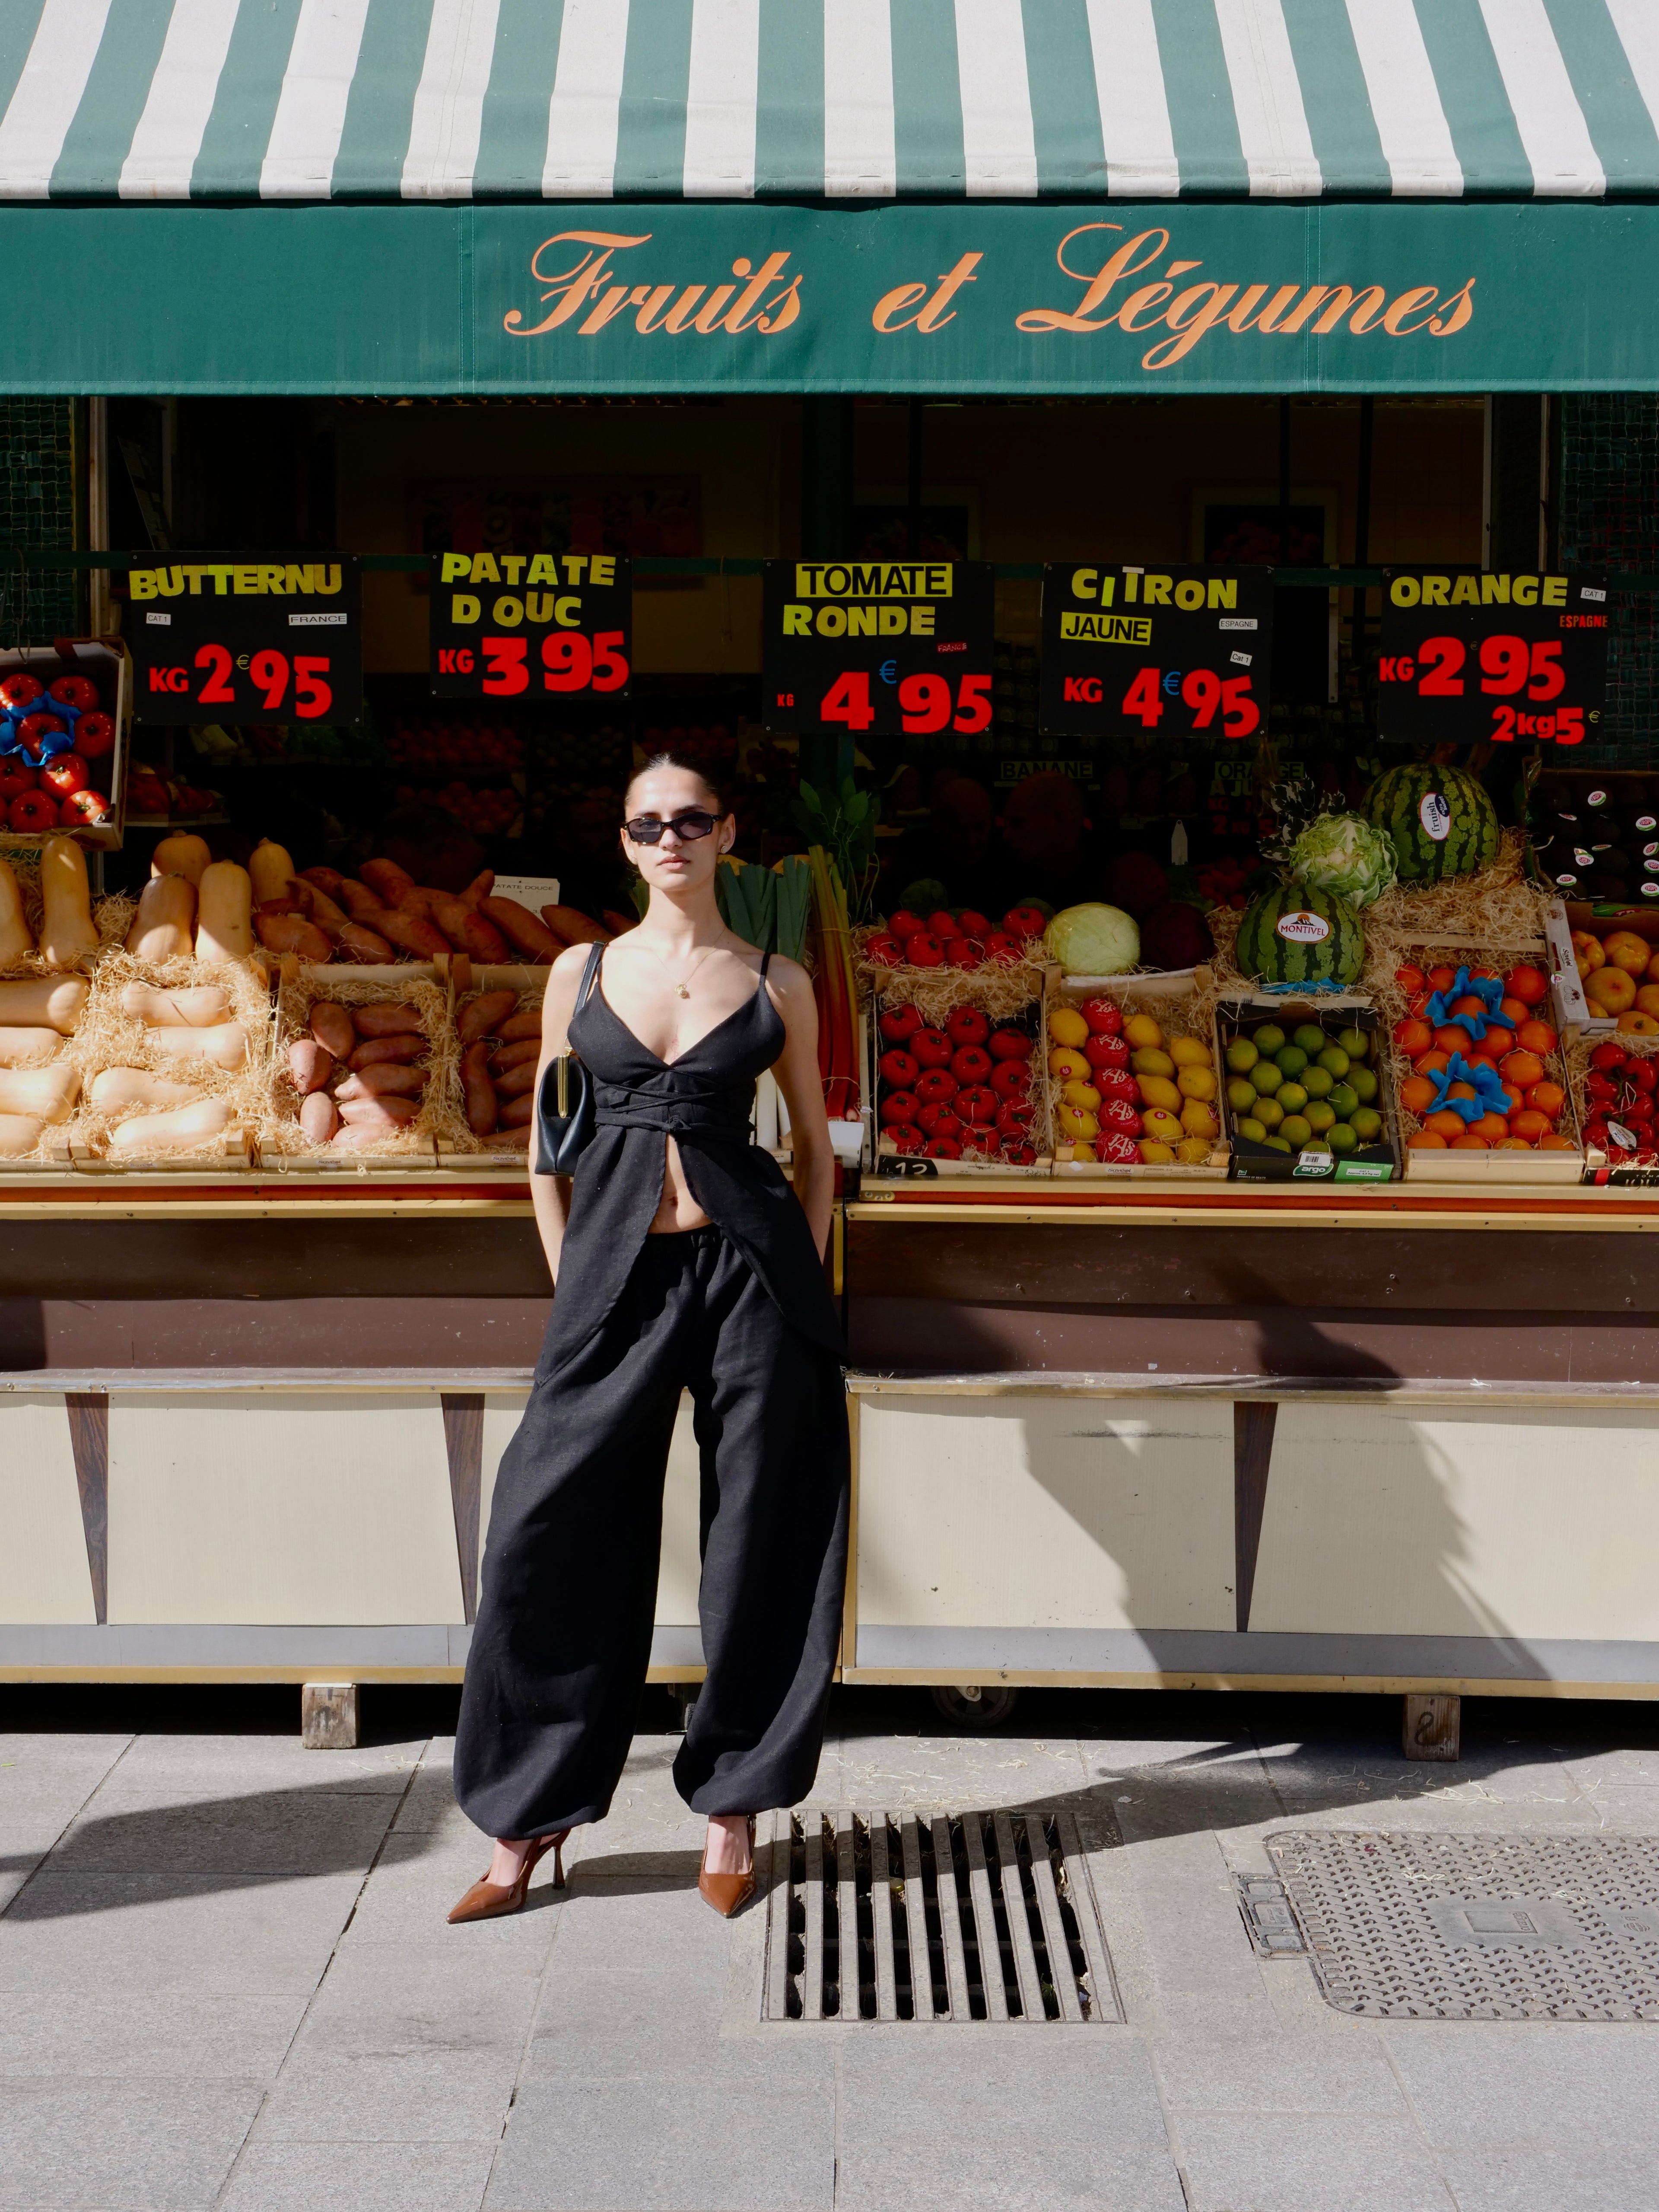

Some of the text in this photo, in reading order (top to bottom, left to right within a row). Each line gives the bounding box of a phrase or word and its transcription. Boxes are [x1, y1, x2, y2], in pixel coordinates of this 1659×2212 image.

[504, 223, 1475, 369] Fruits et Légumes
[441, 552, 616, 586] PATATE
[802, 566, 947, 595] TOMATE
[129, 564, 342, 600] BUTTERNU
[1071, 566, 1237, 611] CITRON
[1390, 574, 1568, 607] ORANGE
[1584, 590, 1598, 598] CAT
[783, 604, 935, 637] RONDE
[1066, 616, 1149, 642] JAUNE
[1560, 615, 1608, 628] ESPAGNE
[938, 643, 967, 652] FRANCE
[1232, 653, 1243, 662] Cat
[439, 649, 474, 673] KG
[1379, 657, 1414, 681] KG
[149, 667, 188, 692] KG
[1064, 677, 1103, 702] KG
[778, 694, 794, 706] KG
[1003, 762, 1091, 778] BANANE
[1218, 762, 1301, 778] ORGE
[1427, 802, 1440, 832] fruish
[1281, 925, 1325, 936] MONTIVEL
